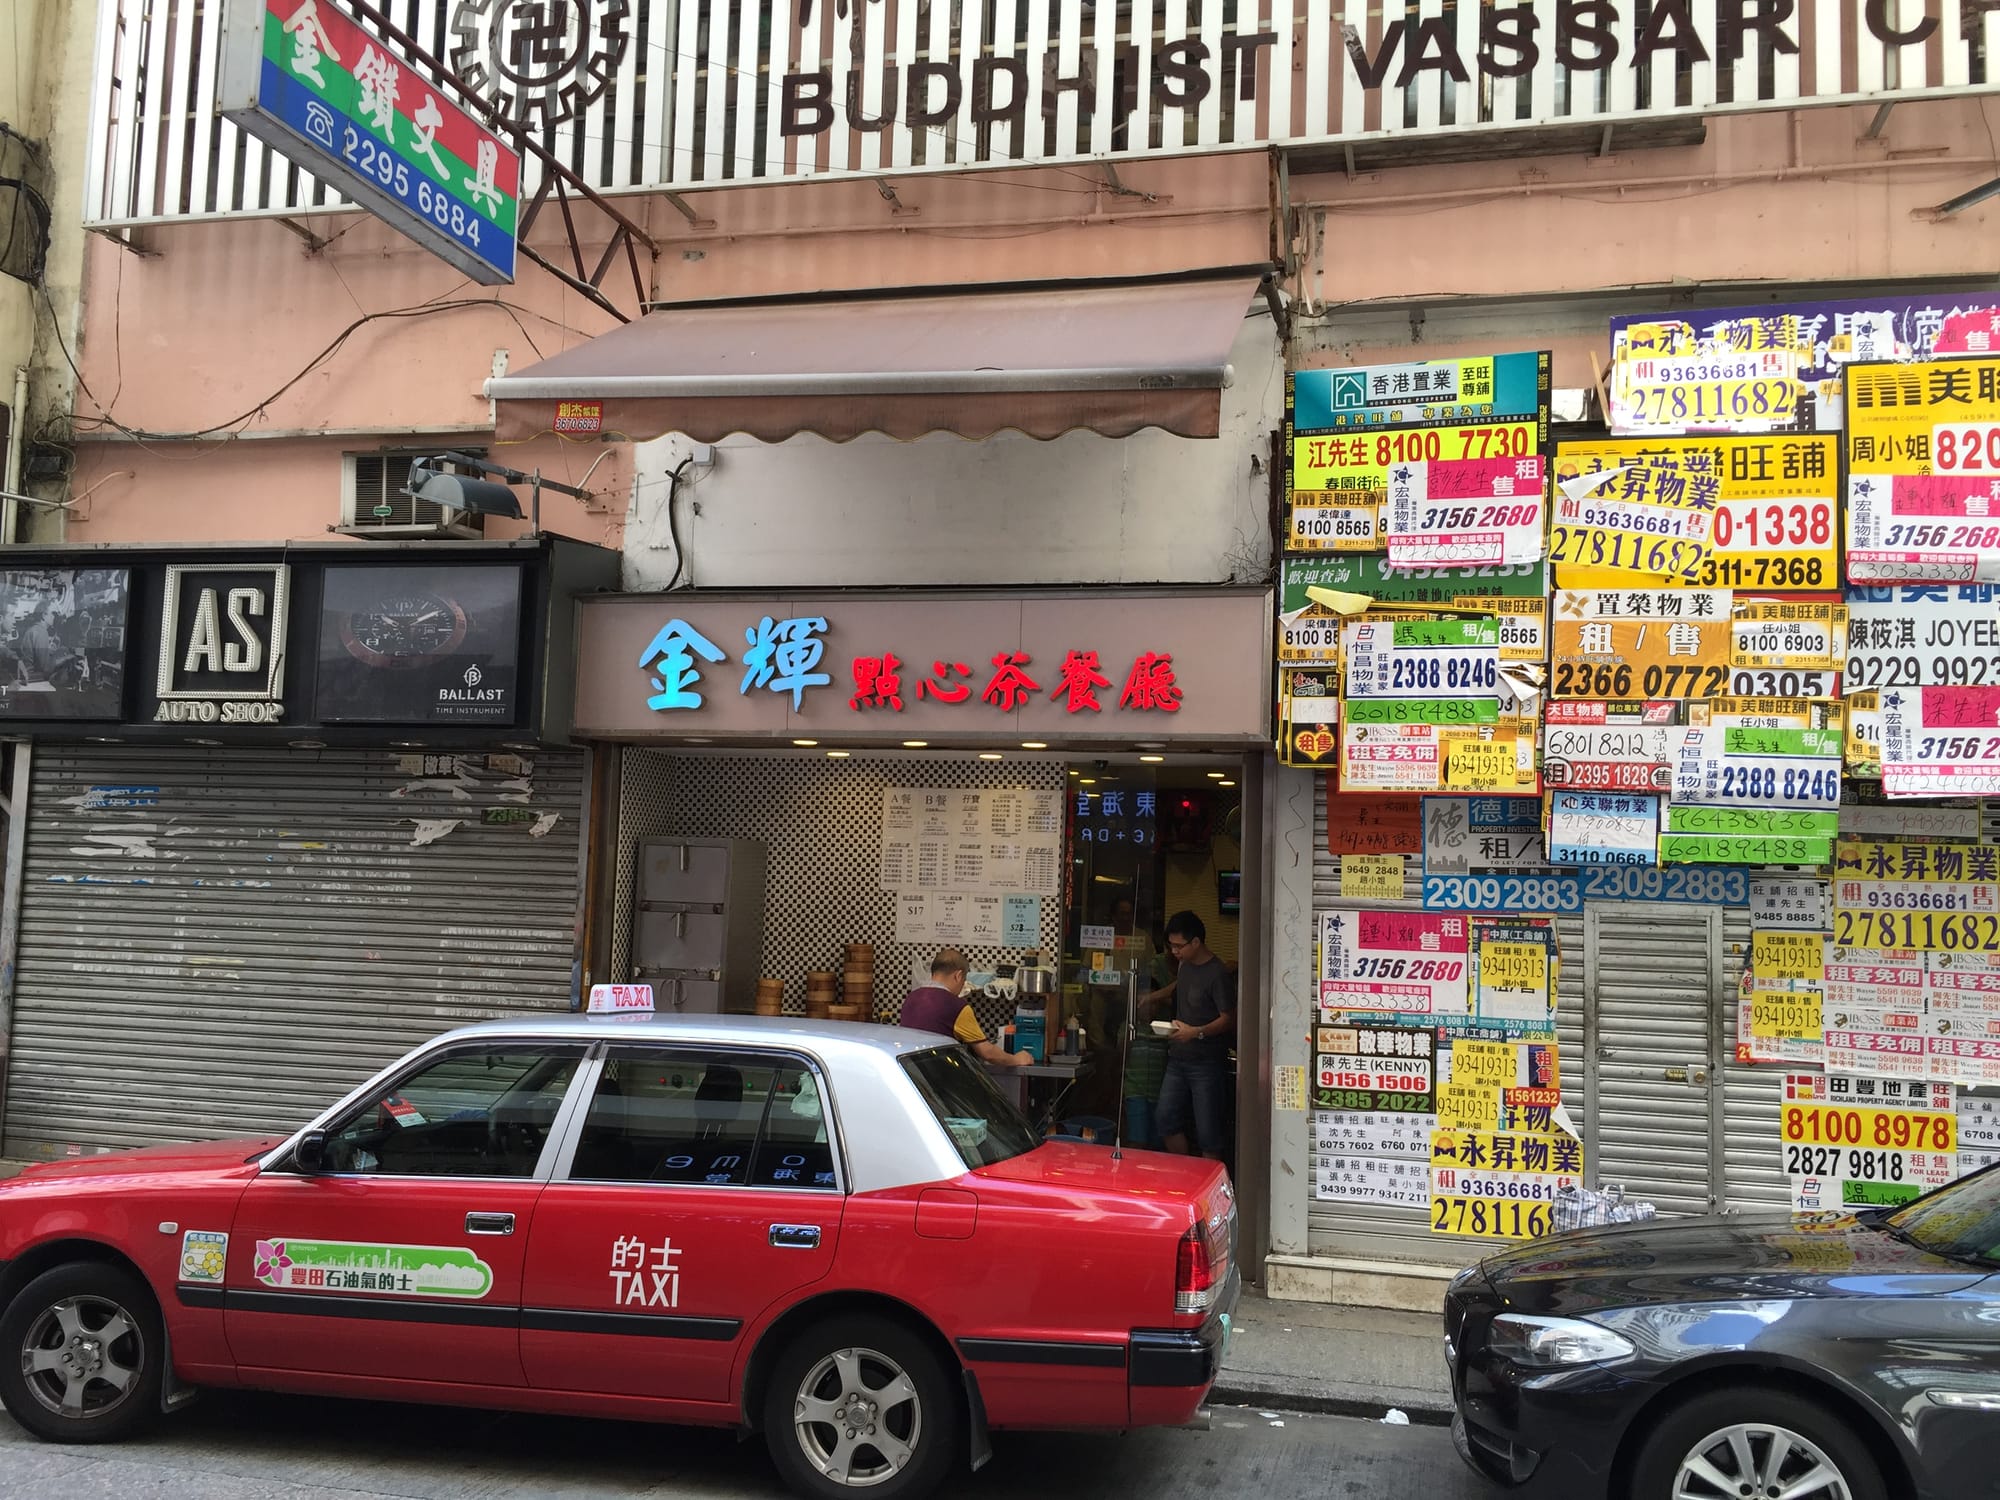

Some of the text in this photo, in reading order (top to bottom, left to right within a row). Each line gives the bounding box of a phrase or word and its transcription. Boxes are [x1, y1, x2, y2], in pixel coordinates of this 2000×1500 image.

[780, 0, 1801, 137] BUDDHIST VASSAR
[282, 2, 503, 219] 金鑽文具
[343, 128, 482, 248] 2295 6884
[1372, 370, 1451, 395] 香港置業
[1660, 363, 1757, 382] 93636681
[1632, 381, 1789, 420] 27811682
[1308, 440, 1368, 468] 江先生
[1376, 432, 1440, 467] 8100
[1459, 427, 1528, 460] 7730
[1852, 435, 1931, 463] 周小姐
[1515, 460, 1539, 480] 租
[1492, 476, 1515, 495] 售
[1319, 493, 1376, 506] 美聯旺舖
[1394, 487, 1410, 533] 宏星物業
[1965, 495, 1990, 516] 售
[1298, 520, 1370, 535] 8100 8565
[1421, 504, 1538, 529] 3156 2680
[1584, 509, 1682, 535] 93636681
[1855, 500, 1872, 548] 宏星物業
[1885, 524, 1948, 547] 3156
[1551, 527, 1702, 580] 27811682
[1288, 568, 1351, 585] 歡迎查詢
[1595, 593, 1714, 617] 置榮物業
[1763, 605, 1829, 619] 美聯旺舖
[184, 588, 264, 672] AS
[1286, 631, 1319, 645] 8100
[1501, 629, 1537, 643] 8565
[1763, 624, 1800, 633] 任小姐
[1849, 617, 1916, 650] 陳筱淇
[1739, 635, 1823, 651] 8100 6903
[638, 615, 1184, 714] 金輝 點心茶餐廳
[1352, 642, 1374, 694] 恒昌物業
[1392, 657, 1496, 689] 2388 8246
[1848, 657, 1921, 686] 9229
[1555, 664, 1721, 698] 2366 0772
[1734, 672, 1822, 696] 0305
[440, 689, 504, 700] BALLAST
[153, 701, 284, 722] AUTO SHOP
[1351, 702, 1475, 721] 60189488
[1548, 703, 1606, 716] 天匡物業
[1741, 699, 1808, 713] 美聯旺舖
[1740, 717, 1779, 728] 任小姐
[1299, 733, 1332, 752] 租售
[1549, 731, 1649, 757] 6801 8212
[1885, 713, 1903, 762] 宏星物業
[1917, 737, 1981, 759] 3156
[1352, 746, 1434, 760] 租客免佣
[1451, 755, 1514, 776] 93419313
[1576, 765, 1672, 785] 2395 1828 售
[1677, 746, 1702, 801] 恒昌物業
[1722, 766, 1837, 801] 2388 8246
[1471, 799, 1540, 823] 德興
[1581, 796, 1648, 813] 英聯物業
[1673, 807, 1817, 832] 96438936
[1560, 849, 1647, 864] 3110 0668
[1668, 839, 1807, 861] 60189488
[1347, 865, 1399, 875] 9649 2848
[1866, 845, 1999, 881] 永昇物業
[1427, 878, 1500, 908] 2309
[1504, 879, 1579, 910] 2883
[1585, 866, 1746, 901] 2309 2883
[1868, 892, 1968, 910] 93636681
[1755, 912, 1815, 921] 9485 8885
[1442, 919, 1463, 937] 租
[1837, 912, 1999, 950] 27811682
[1420, 932, 1441, 950] 售
[1328, 934, 1342, 979] 宏星物業
[1483, 957, 1544, 978] 93419313
[1756, 947, 1821, 968] 93419313
[1353, 958, 1463, 981] 3156 2680
[1828, 967, 1919, 984] 租客免佣
[612, 987, 650, 1007] TAXI
[1325, 992, 1425, 1011] 63032338
[1424, 1015, 1466, 1026] 2576 8081
[1504, 1020, 1547, 1030] 2576 8081
[1754, 1006, 1820, 1028] 93419313
[1829, 1033, 1921, 1051] 租客免佣
[1456, 1054, 1517, 1077] 93419313
[1536, 1051, 1552, 1083] 租售
[1321, 1072, 1425, 1091] 9156 1506
[1831, 1078, 1927, 1097] 田豐地產
[1319, 1090, 1429, 1111] 2385 2022
[1831, 1095, 1855, 1103] RICHLAND
[1857, 1097, 1883, 1105] PROPERTY
[1933, 1084, 1949, 1108] 旺舖
[1437, 1097, 1498, 1120] 93419313
[1329, 1128, 1366, 1138] 沈先生
[1787, 1108, 1950, 1149] 8100 8978
[1965, 1130, 1993, 1140] 6708
[1319, 1141, 1405, 1150] 6075 7602 6760
[1460, 1134, 1581, 1173] 永昇物業
[1788, 1146, 1903, 1181] 2827 9818
[1910, 1154, 1948, 1168] 租售
[1329, 1172, 1366, 1183] 張先生
[1437, 1169, 1552, 1200] 租 93636681
[1321, 1185, 1405, 1200] 9439 9977 9347
[611, 1235, 683, 1271] 的士
[291, 1268, 413, 1291] 豐田石油氣的士
[609, 1270, 680, 1307] TAXI
